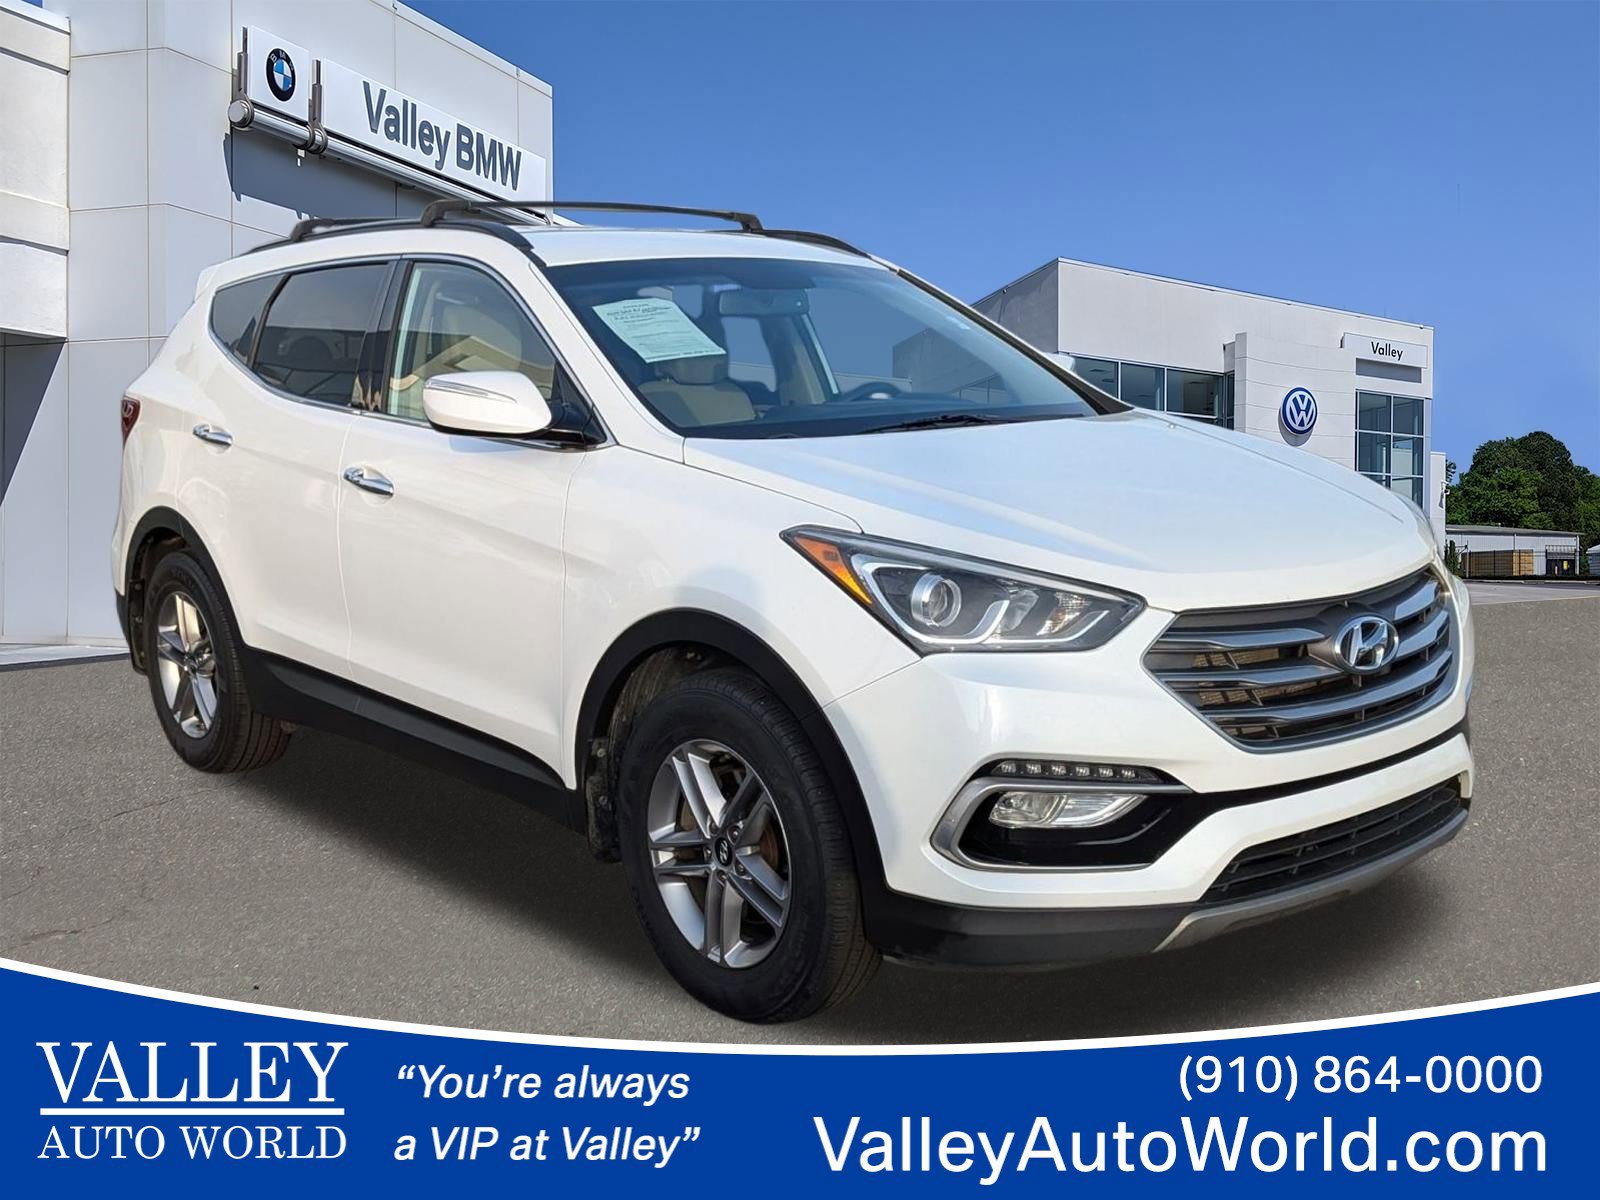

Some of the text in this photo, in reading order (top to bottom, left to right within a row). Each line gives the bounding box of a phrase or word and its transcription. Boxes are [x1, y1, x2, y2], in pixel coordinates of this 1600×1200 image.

[362, 80, 522, 191] Valley BMW
[1371, 341, 1403, 361] Valley
